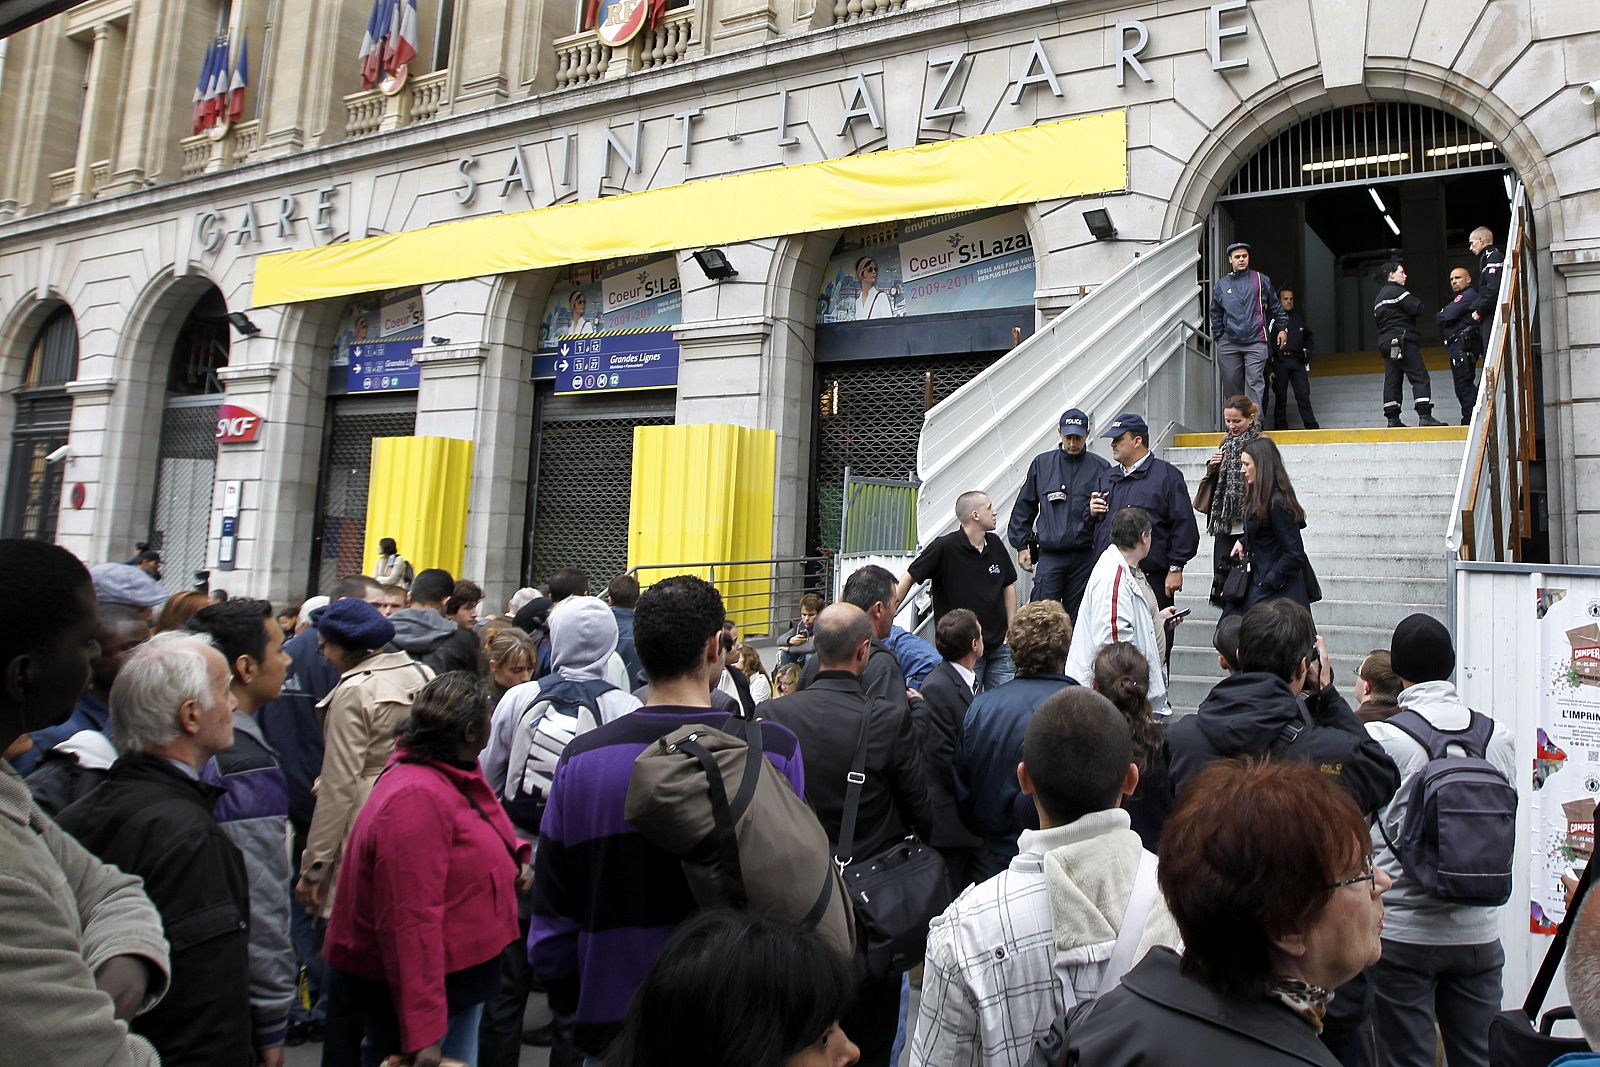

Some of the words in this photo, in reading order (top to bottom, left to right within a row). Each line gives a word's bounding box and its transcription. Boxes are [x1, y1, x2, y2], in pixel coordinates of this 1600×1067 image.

[606, 1, 637, 26] RF
[198, 185, 335, 252] GARE
[454, 108, 703, 205] SAINT
[778, 0, 1249, 148] LAZARE
[910, 251, 954, 272] Coeur
[608, 286, 641, 304] Coeur
[911, 272, 974, 299] 2009-2011
[385, 315, 410, 330] Coeur
[609, 304, 657, 328] 2009-2011
[610, 353, 638, 364] Grandes
[639, 352, 661, 364] Lignes
[610, 375, 619, 385] 12
[216, 416, 256, 437] SNCF
[1574, 648, 1600, 660] CAMPER
